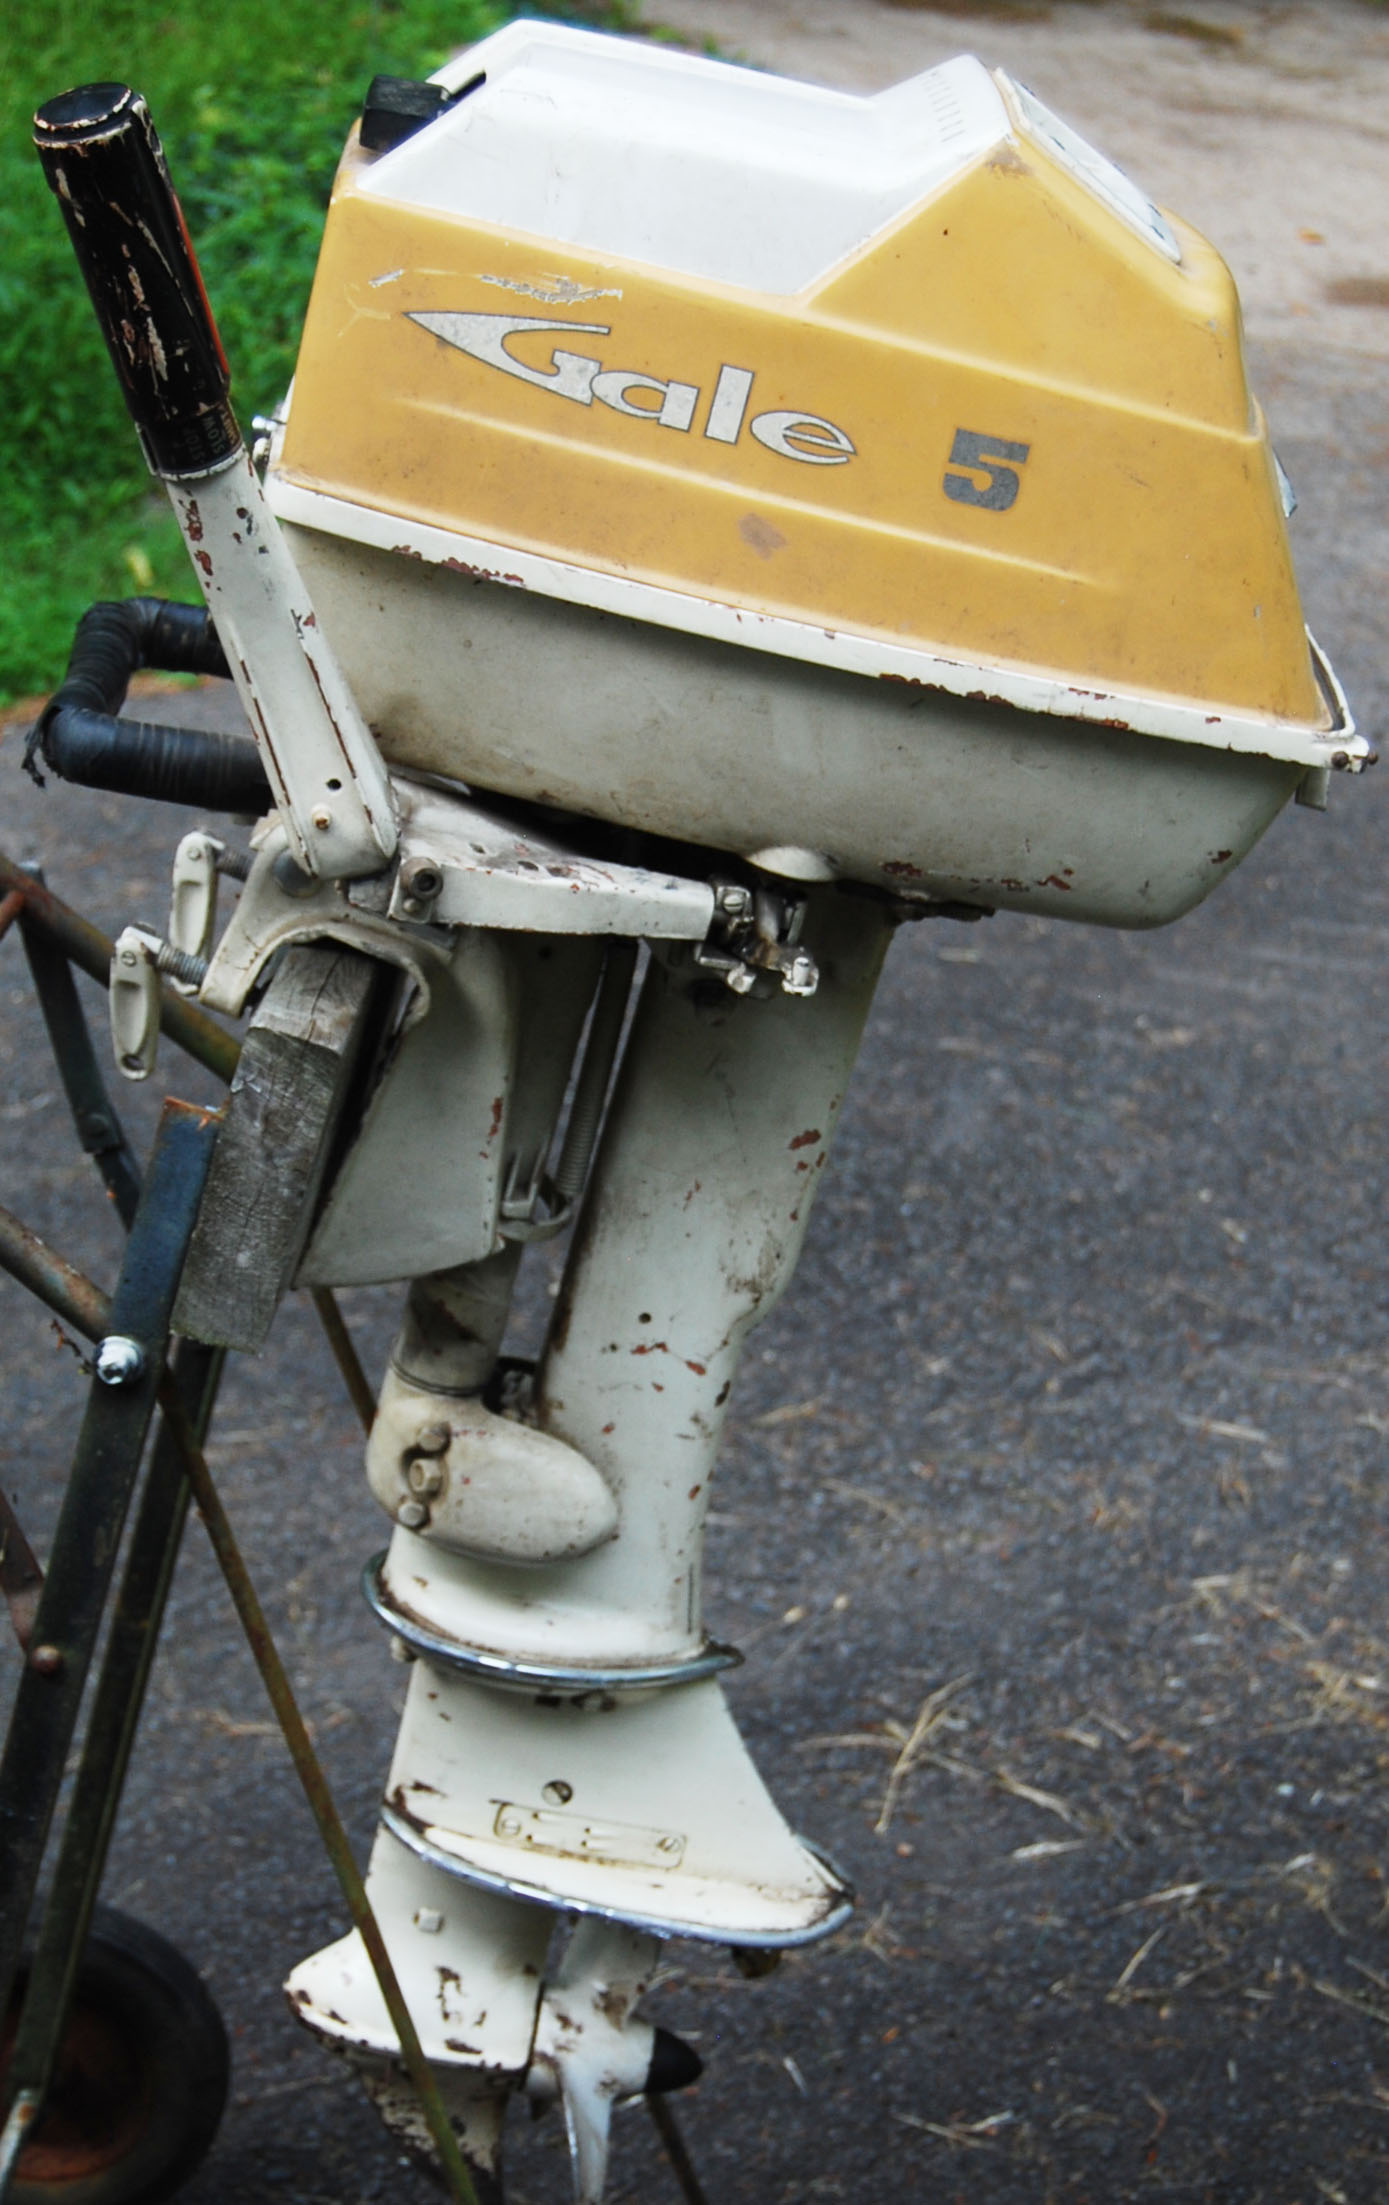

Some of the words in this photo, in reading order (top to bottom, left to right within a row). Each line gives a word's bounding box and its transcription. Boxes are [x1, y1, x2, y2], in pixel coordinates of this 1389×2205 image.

[202, 415, 226, 454] SLOW
[401, 310, 858, 466] Gale
[942, 427, 1032, 513] 5
